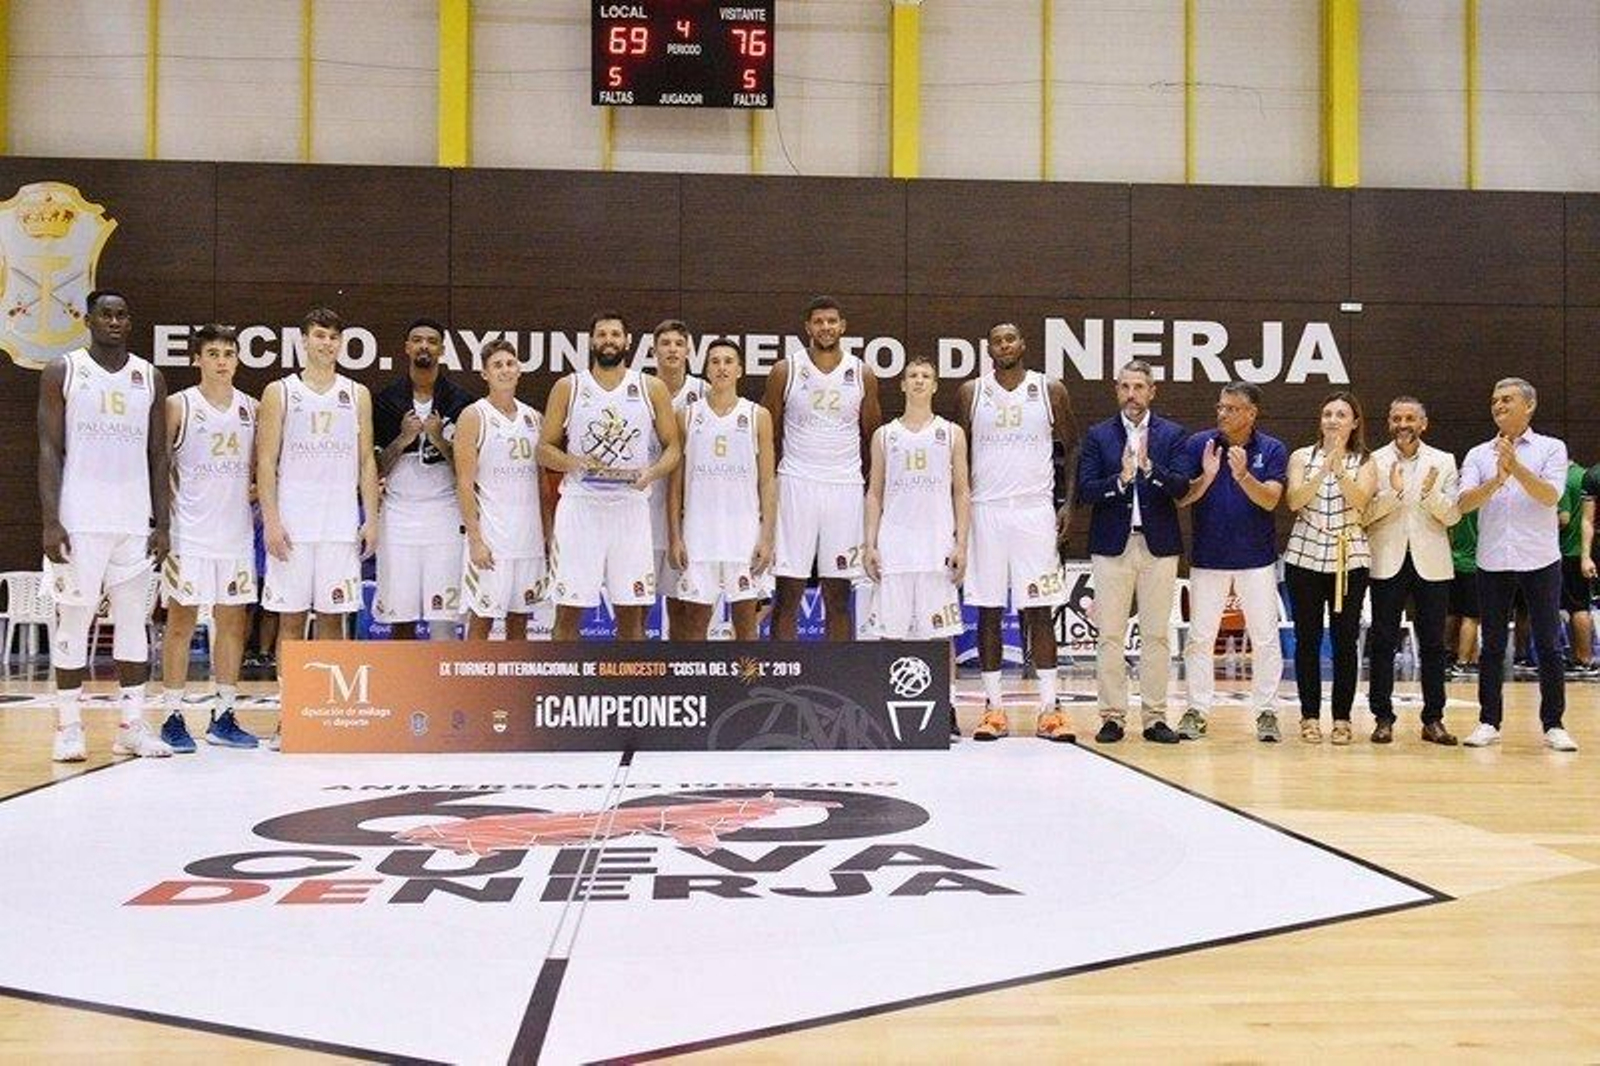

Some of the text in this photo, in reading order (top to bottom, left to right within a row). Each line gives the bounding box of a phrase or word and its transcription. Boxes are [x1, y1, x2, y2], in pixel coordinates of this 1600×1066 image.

[600, 5, 648, 19] LOCAL
[719, 7, 767, 21] VISITANTE
[676, 20, 690, 38] 4
[609, 27, 648, 54] 69
[666, 43, 702, 55] PERIODO
[732, 29, 767, 56] 76
[600, 91, 634, 104] FALTAS
[659, 93, 703, 105] JUGADOR
[733, 94, 768, 106] FALTAS
[154, 324, 393, 371] ECO.
[1045, 318, 1350, 385] NERJA
[99, 390, 126, 416] 16
[812, 389, 842, 411] 22
[310, 410, 333, 435] 17
[994, 405, 1021, 428] 33
[211, 431, 240, 456] 24
[507, 437, 532, 459] 20
[715, 435, 727, 457] 6
[904, 448, 927, 470] 18
[1040, 571, 1063, 597] 33
[454, 662, 496, 676] TORNEO
[498, 662, 580, 676] INTERNACIONAL
[583, 662, 597, 676] DE
[599, 662, 667, 677] BALONCESTO
[709, 662, 729, 676] DEL
[773, 662, 801, 676] 2019
[303, 661, 373, 704] M
[535, 695, 707, 727] ¡CAMPEONES!
[183, 844, 999, 879] CUEVA
